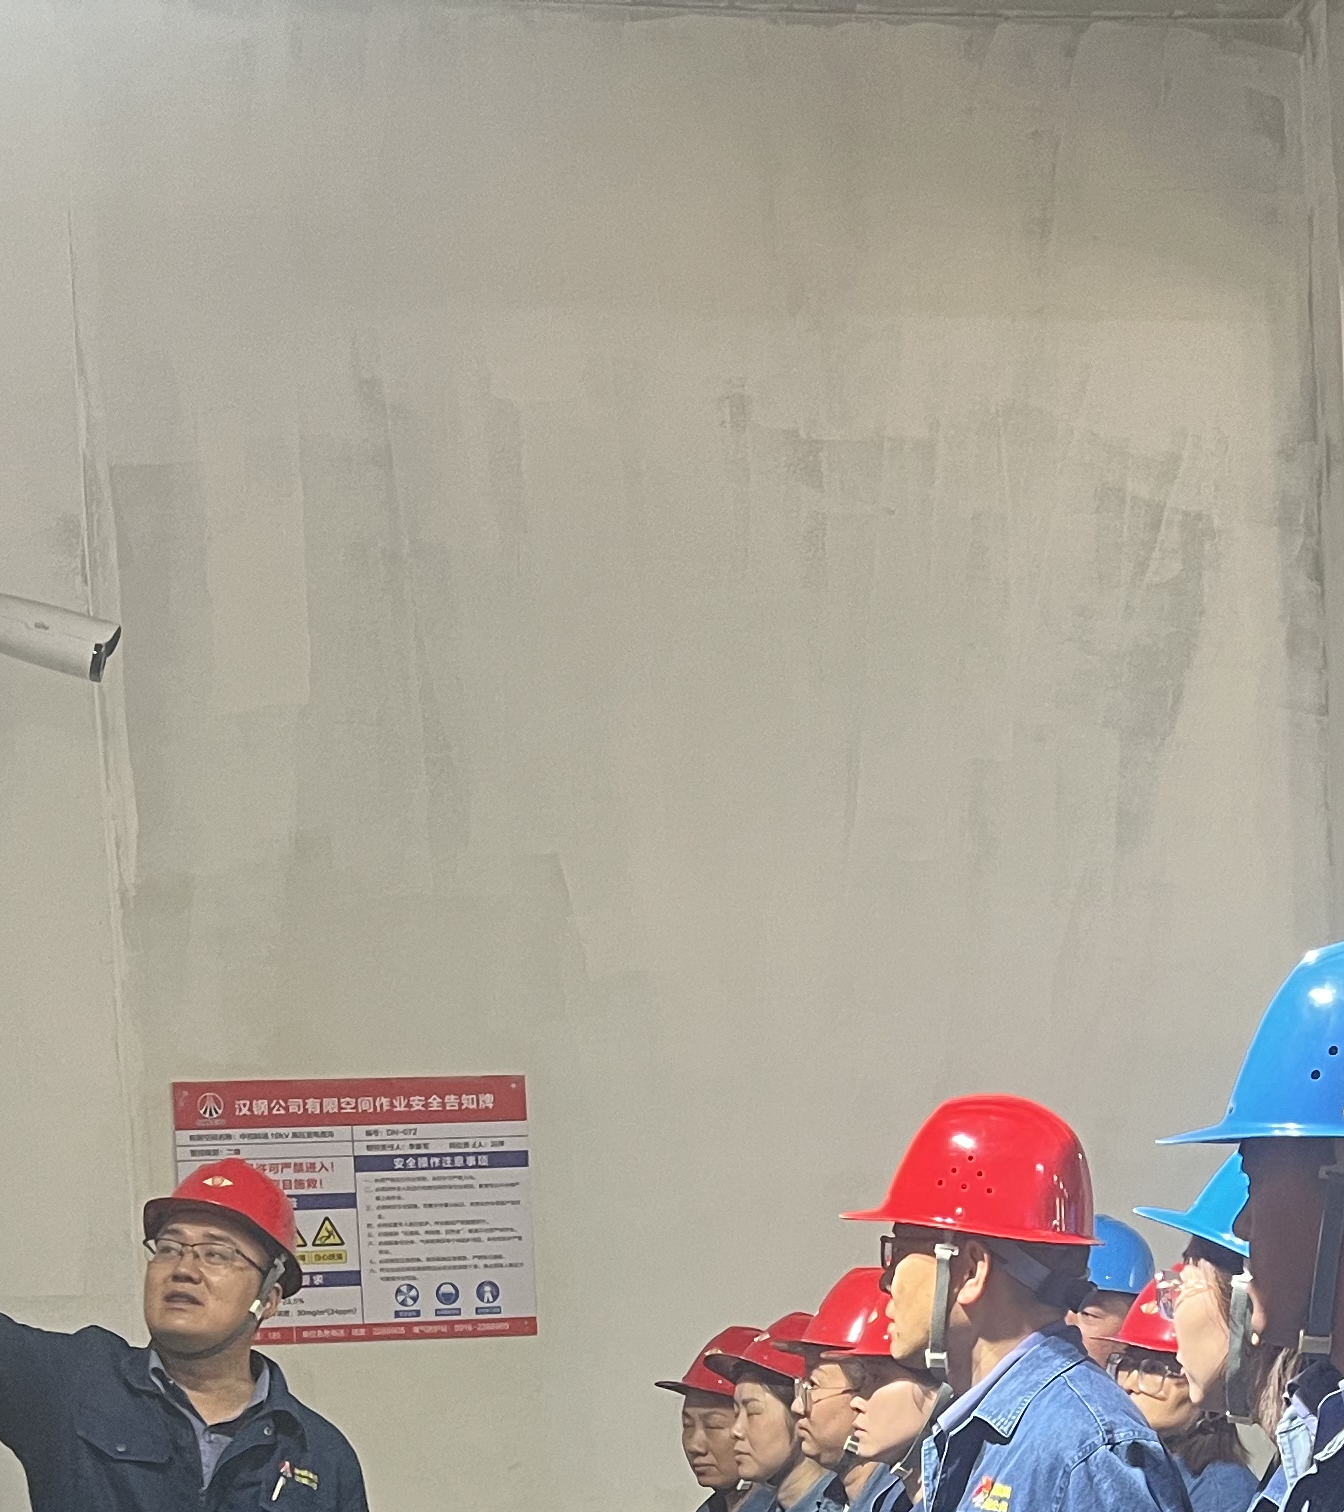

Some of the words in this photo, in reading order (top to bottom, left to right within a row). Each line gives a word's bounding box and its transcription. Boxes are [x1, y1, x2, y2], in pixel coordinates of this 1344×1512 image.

[235, 1093, 495, 1117] 汉钢公司有限空间作业安全告知牌
[393, 1154, 489, 1170] 安全操作注意事项
